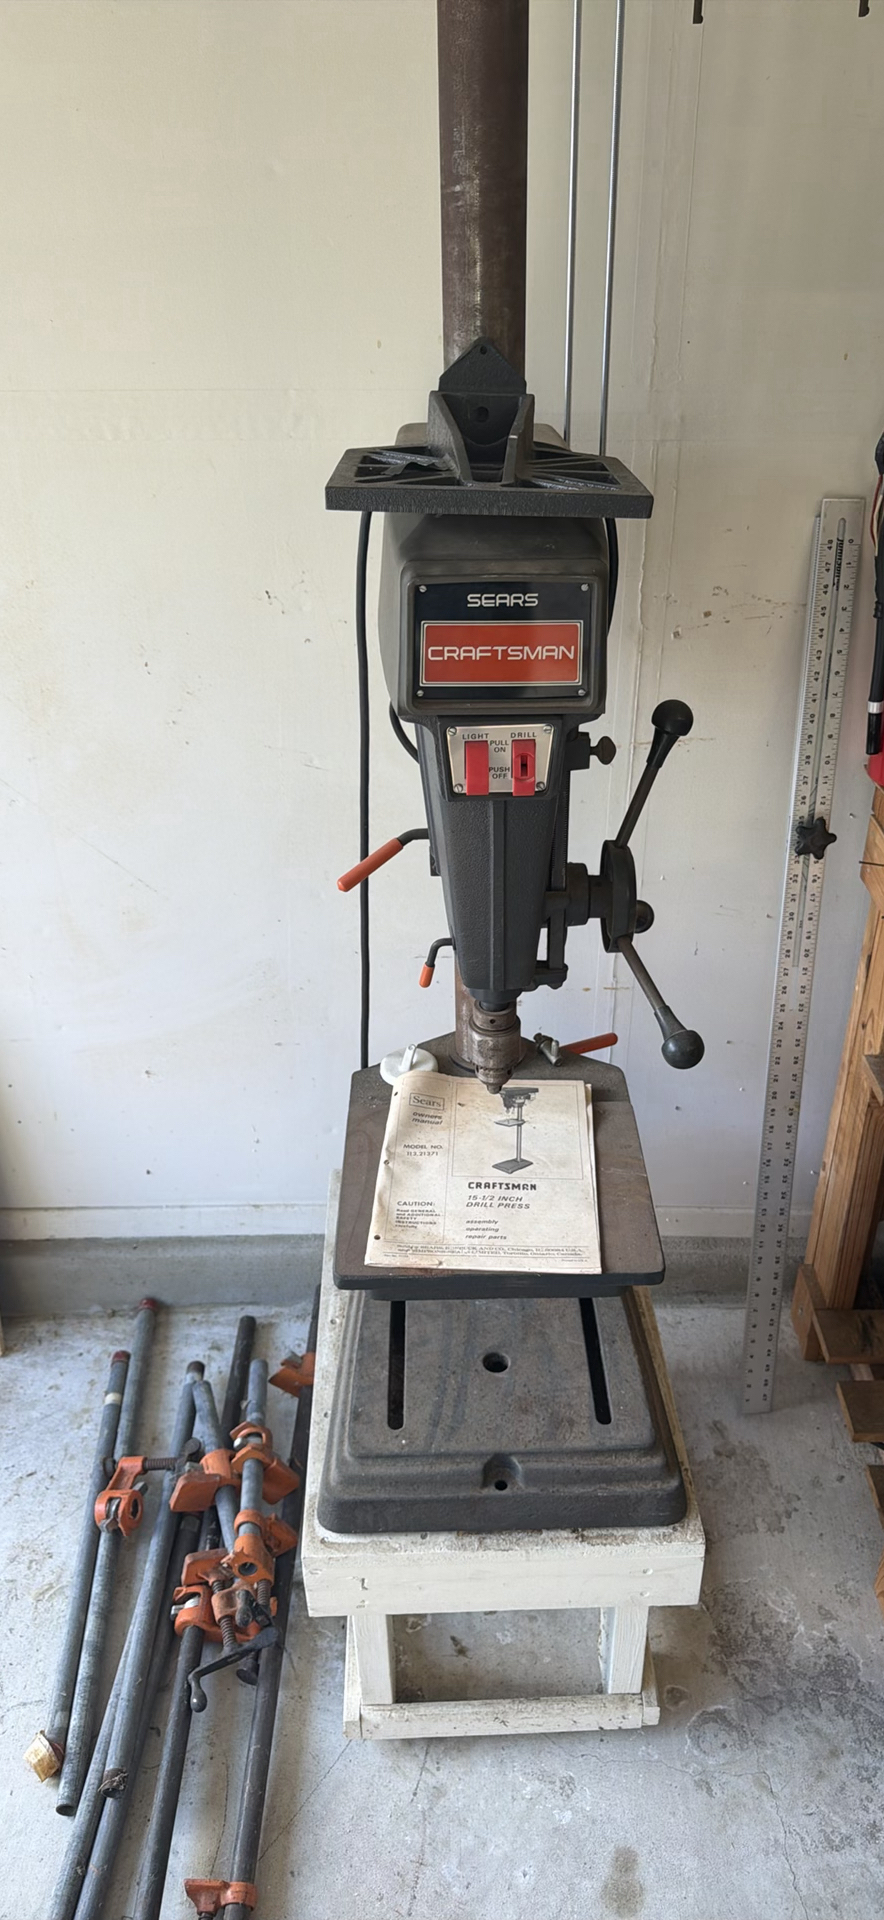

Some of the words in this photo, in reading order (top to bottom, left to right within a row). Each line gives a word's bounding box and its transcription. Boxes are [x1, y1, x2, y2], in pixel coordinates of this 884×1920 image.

[827, 539, 833, 551] 48
[825, 562, 831, 573] 47
[823, 584, 829, 595] 46
[467, 593, 539, 607] SEARS
[821, 606, 827, 617] 45
[818, 628, 824, 639] 44
[428, 645, 575, 661] CRAFTSMAN
[816, 650, 822, 661] 43
[814, 671, 820, 682] 42
[812, 693, 818, 703] 41
[809, 713, 815, 724] 40
[807, 734, 813, 745] 39
[805, 755, 811, 765] 38
[824, 755, 830, 765] 10
[802, 776, 808, 785] 37
[822, 776, 829, 784] 11
[800, 795, 806, 806] 36
[820, 796, 826, 805] 12
[792, 874, 798, 884] 32
[811, 874, 817, 883] 16
[790, 893, 796, 902] 31
[809, 893, 816, 902] 17
[788, 912, 794, 921] 30
[808, 912, 814, 921] 18
[787, 931, 793, 940] 29
[806, 931, 811, 940] 19
[785, 949, 791, 958] 28
[804, 949, 810, 958] 20
[783, 968, 789, 976] 27
[802, 967, 808, 976] 21
[781, 986, 788, 995] 26
[800, 985, 806, 994] 22
[780, 1004, 786, 1012] 25
[798, 1004, 804, 1012] 23
[778, 1021, 784, 1030] 24
[796, 1021, 802, 1030] 24
[776, 1039, 782, 1048] 23
[795, 1038, 801, 1047] 25
[413, 1095, 442, 1108] Sears
[468, 1182, 536, 1190] CRAFTSMAN
